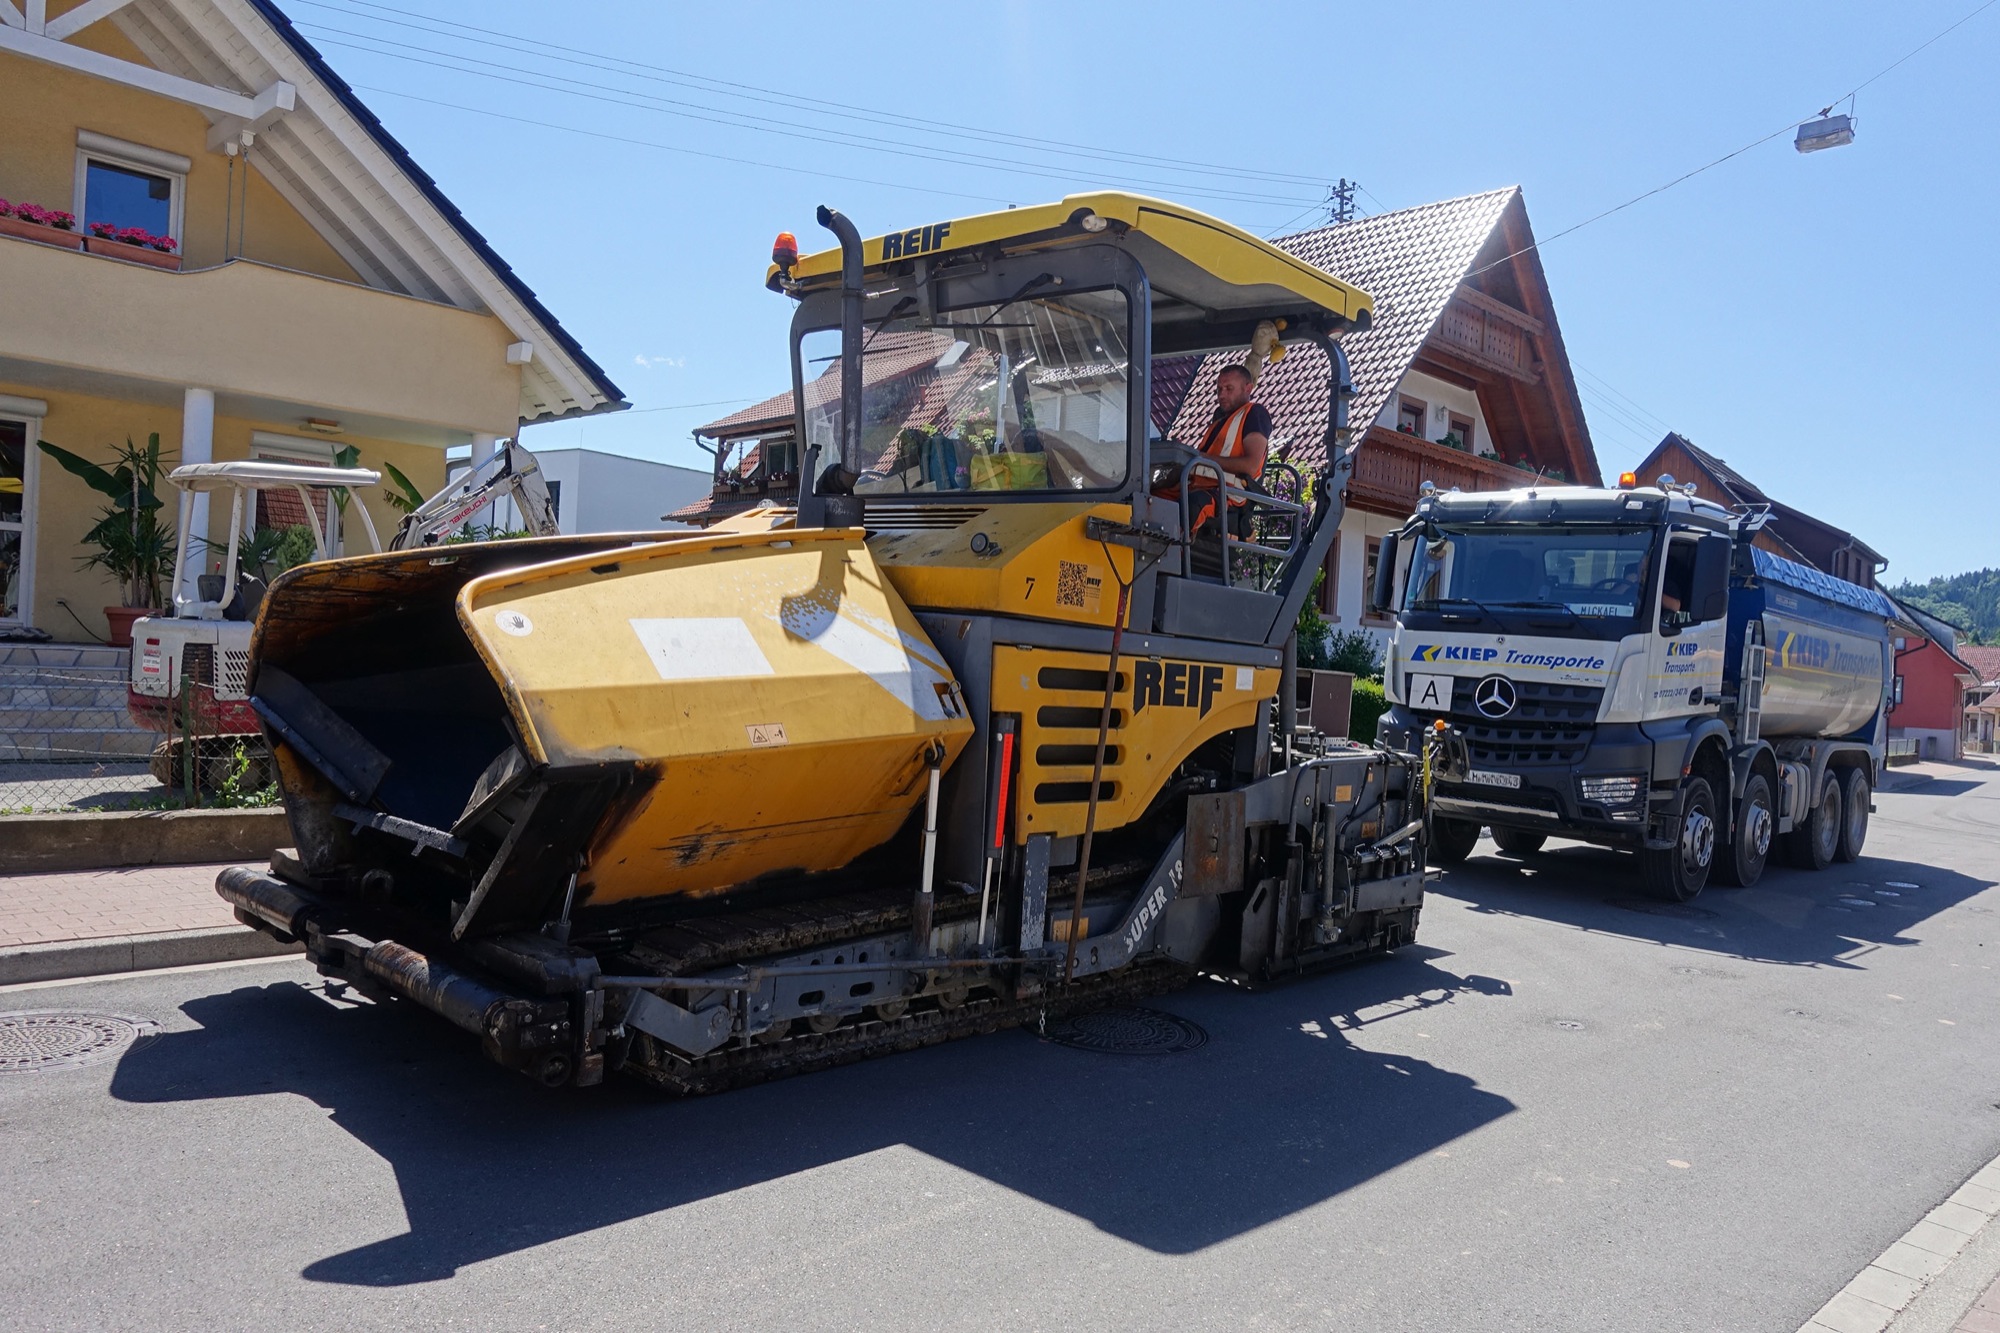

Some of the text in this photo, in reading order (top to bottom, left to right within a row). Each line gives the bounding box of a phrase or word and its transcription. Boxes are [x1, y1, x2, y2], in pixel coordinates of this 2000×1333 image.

[882, 221, 951, 260] REIF
[1025, 577, 1035, 600] 7
[1086, 577, 1101, 587] REIF
[1445, 646, 1605, 670] KIEP Transporte
[1679, 643, 1698, 656] KIEP
[1796, 633, 1879, 683] KIEP Transporte
[1664, 661, 1696, 676] Transporte
[1133, 661, 1224, 721] REIF
[1421, 680, 1439, 705] A
